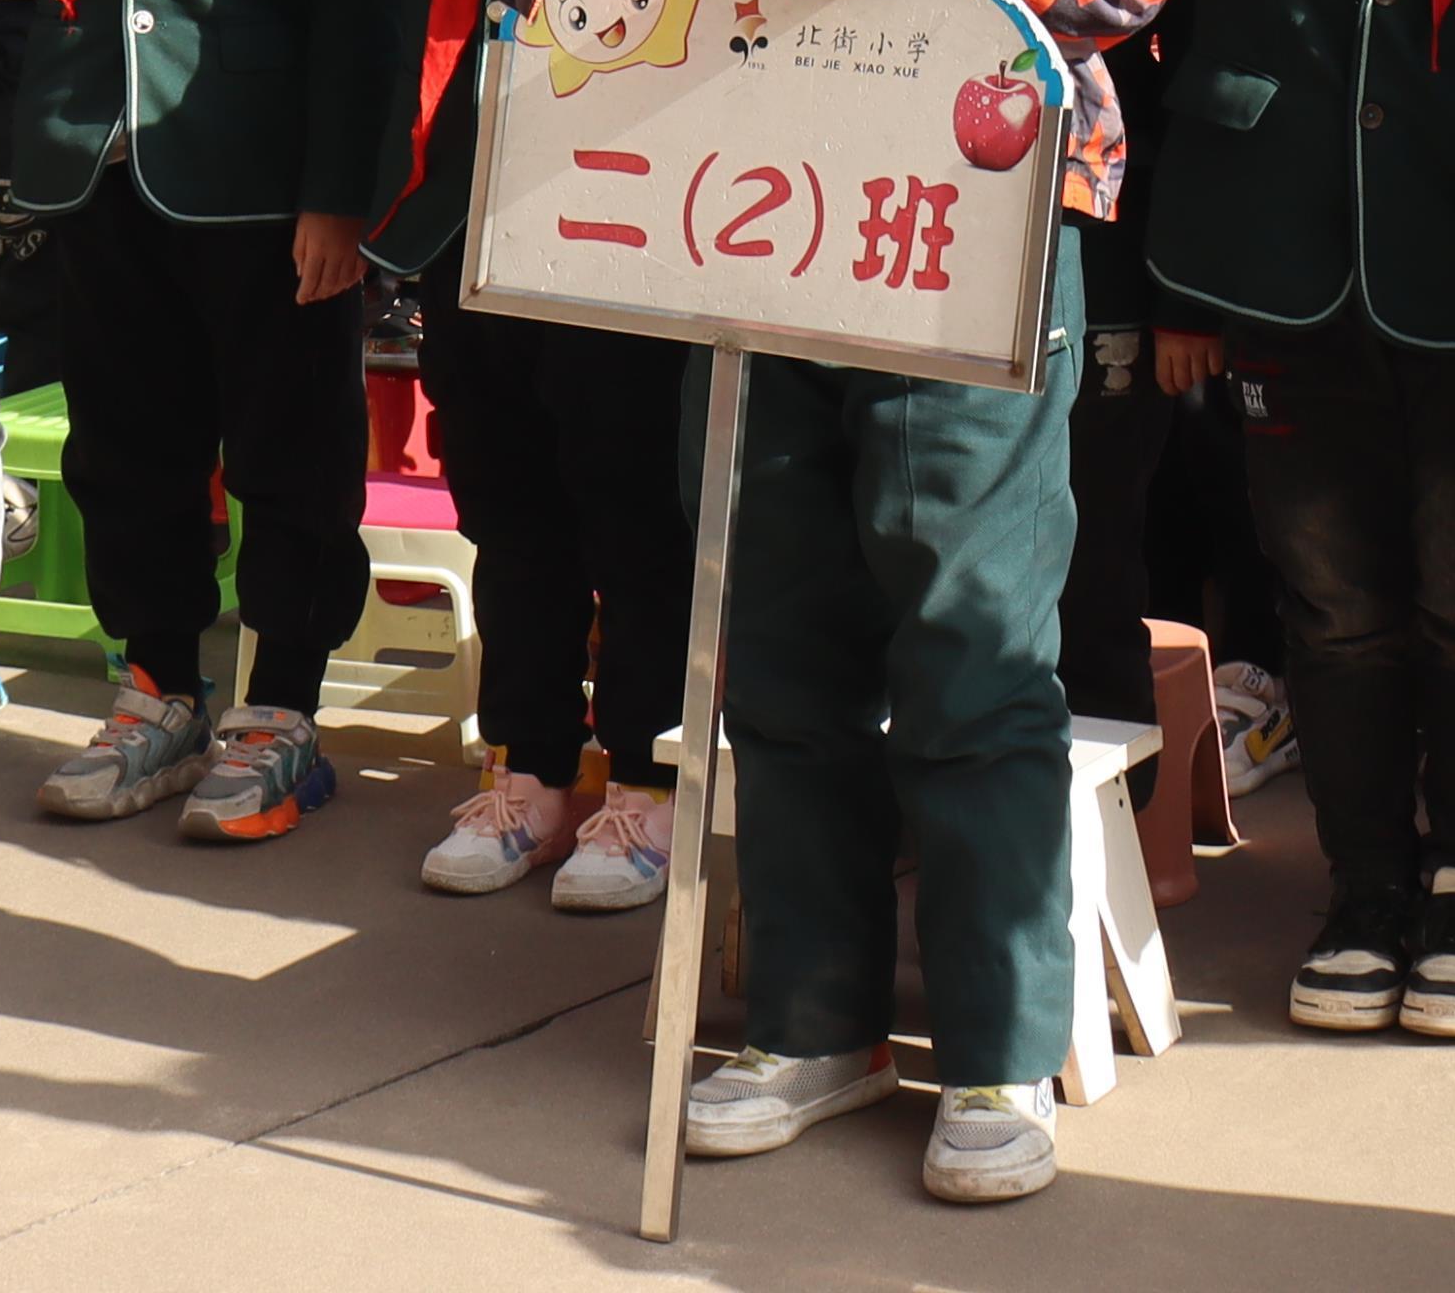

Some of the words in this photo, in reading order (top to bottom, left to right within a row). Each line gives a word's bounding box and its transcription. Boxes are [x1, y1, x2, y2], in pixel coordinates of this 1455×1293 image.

[796, 24, 930, 63] 北街小学
[795, 56, 815, 67] BEI
[822, 59, 841, 70] JIE
[853, 62, 885, 75] XIAO
[893, 66, 920, 79] XUE
[557, 151, 960, 292] 二(2)班
